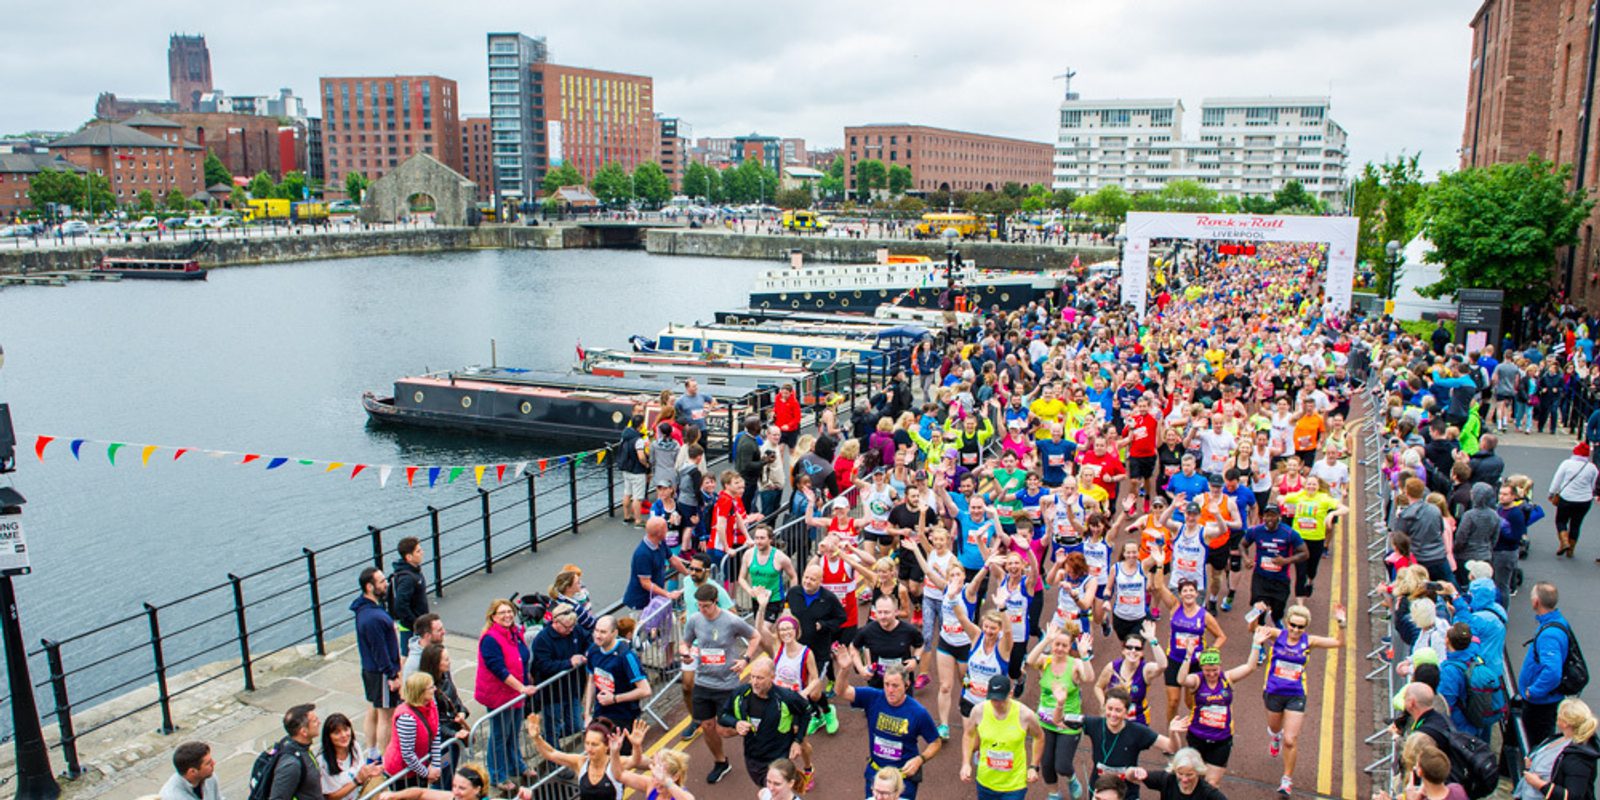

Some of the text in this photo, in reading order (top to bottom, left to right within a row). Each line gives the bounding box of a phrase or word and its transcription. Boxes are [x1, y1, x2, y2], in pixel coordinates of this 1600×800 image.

[1196, 216, 1235, 226] Rock
[1251, 217, 1285, 228] Roll
[1213, 231, 1265, 239] LIVERPOOL
